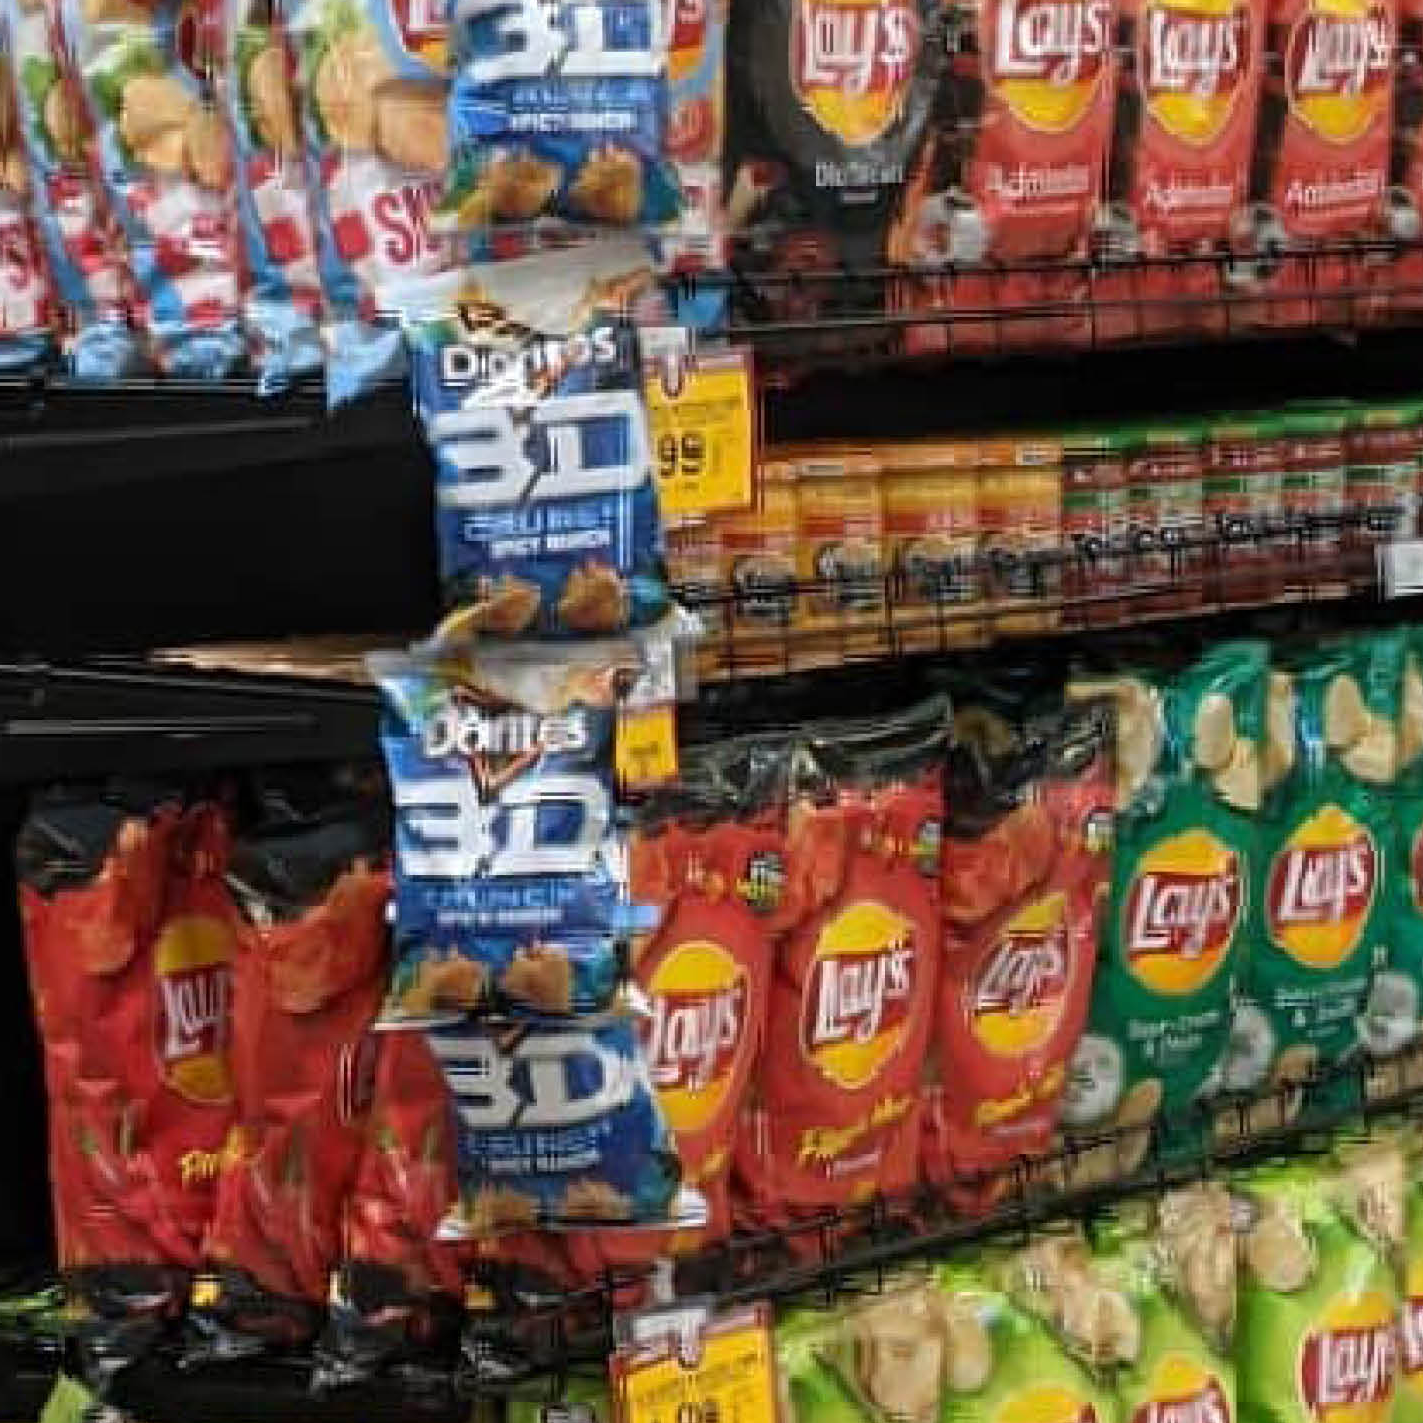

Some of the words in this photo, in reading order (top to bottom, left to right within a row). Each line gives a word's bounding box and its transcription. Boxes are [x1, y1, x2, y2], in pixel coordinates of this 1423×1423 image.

[1150, 6, 1240, 94] Lay's
[1296, 12, 1390, 96] Lay's
[441, 326, 618, 381] Doritos
[429, 390, 651, 508] 3D
[395, 771, 614, 878] 3D
[1132, 871, 1234, 960] Lay's
[1279, 842, 1369, 927] Lay's
[815, 942, 915, 1044] Lay's
[434, 1034, 638, 1130] 3D
